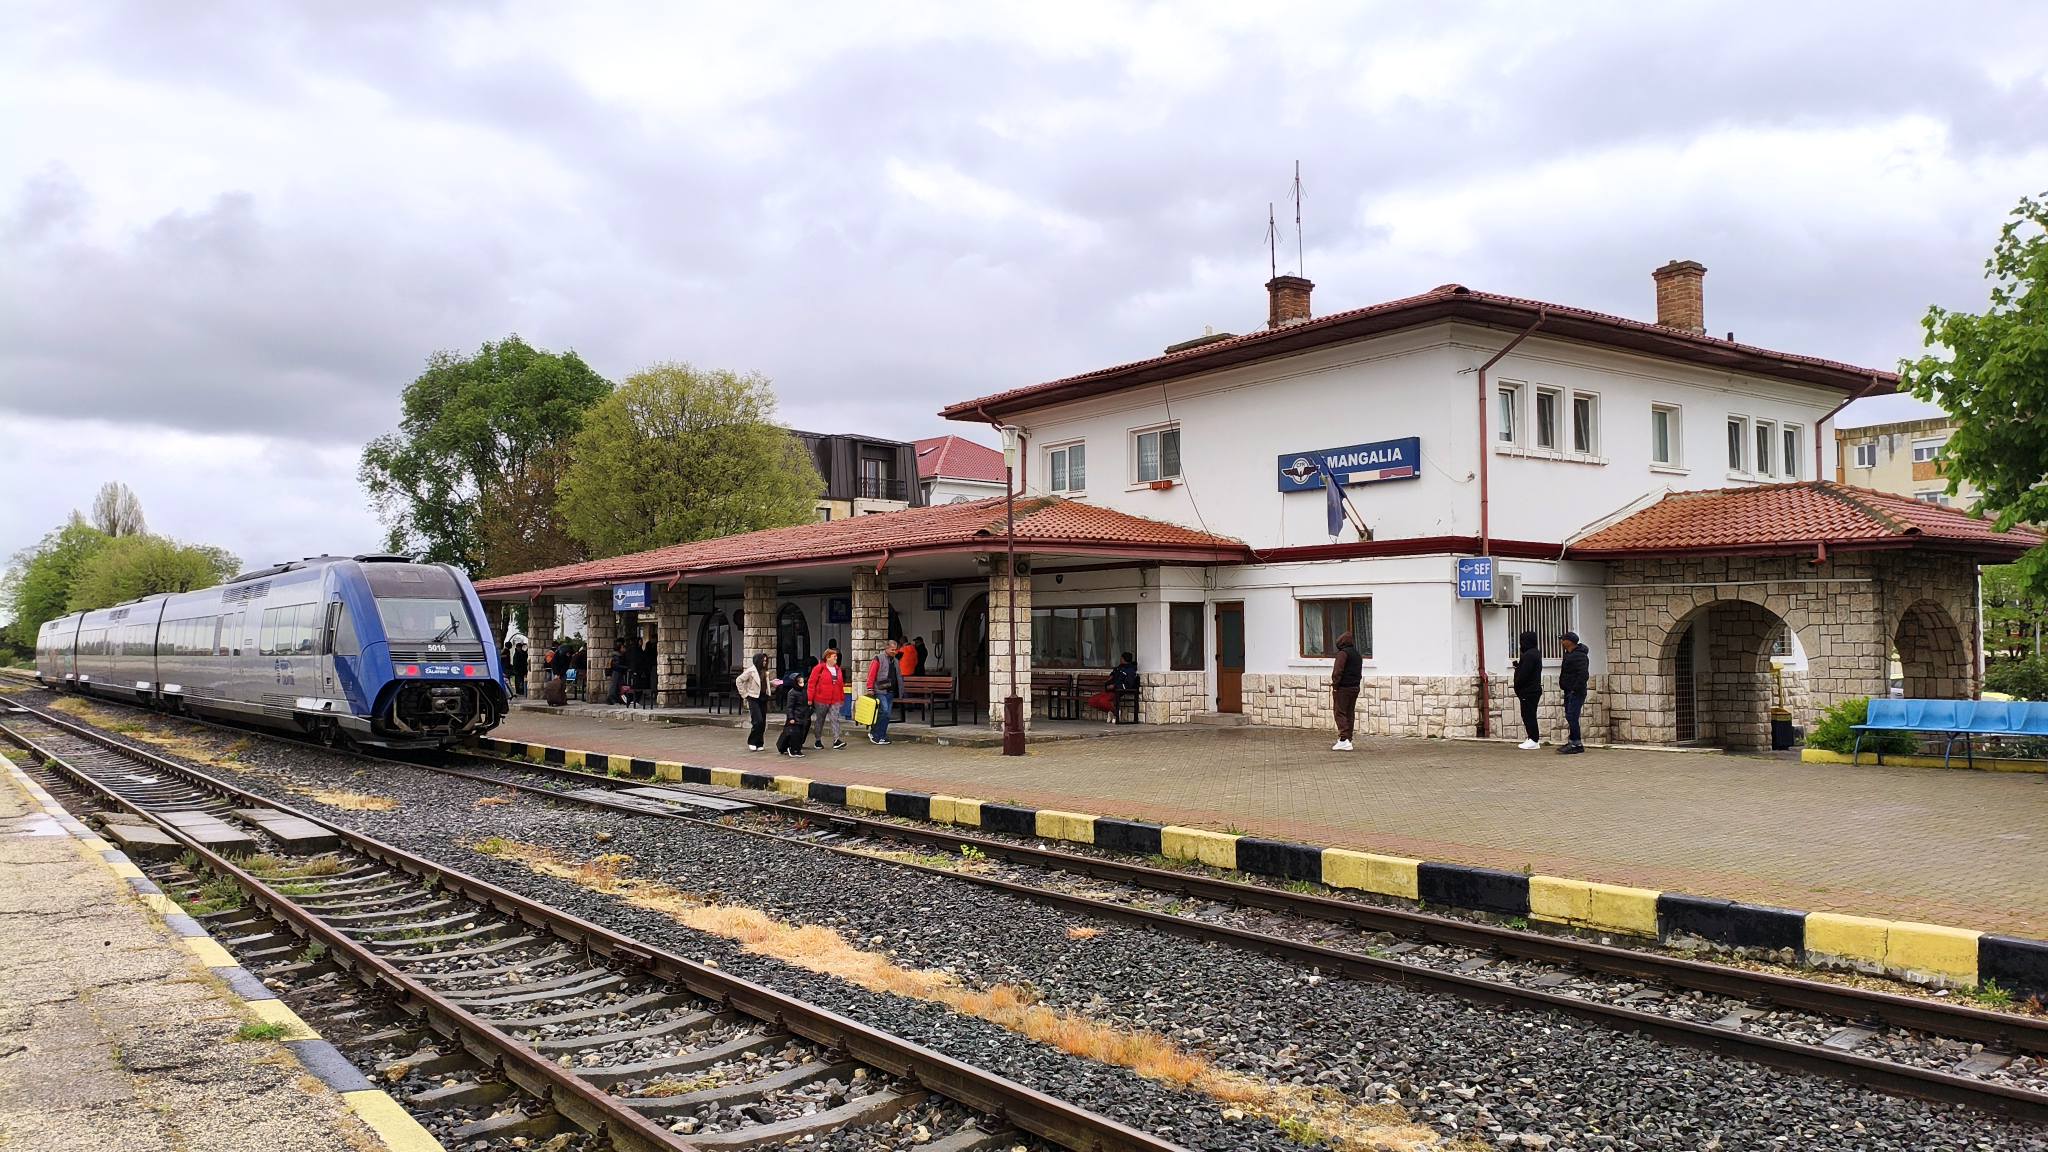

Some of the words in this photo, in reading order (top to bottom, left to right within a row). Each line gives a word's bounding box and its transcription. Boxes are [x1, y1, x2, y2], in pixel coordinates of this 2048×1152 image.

[1327, 447, 1403, 469] MANGALIA
[1474, 563, 1491, 575] SEF
[1460, 579, 1491, 592] STATIE
[427, 644, 447, 652] 5016
